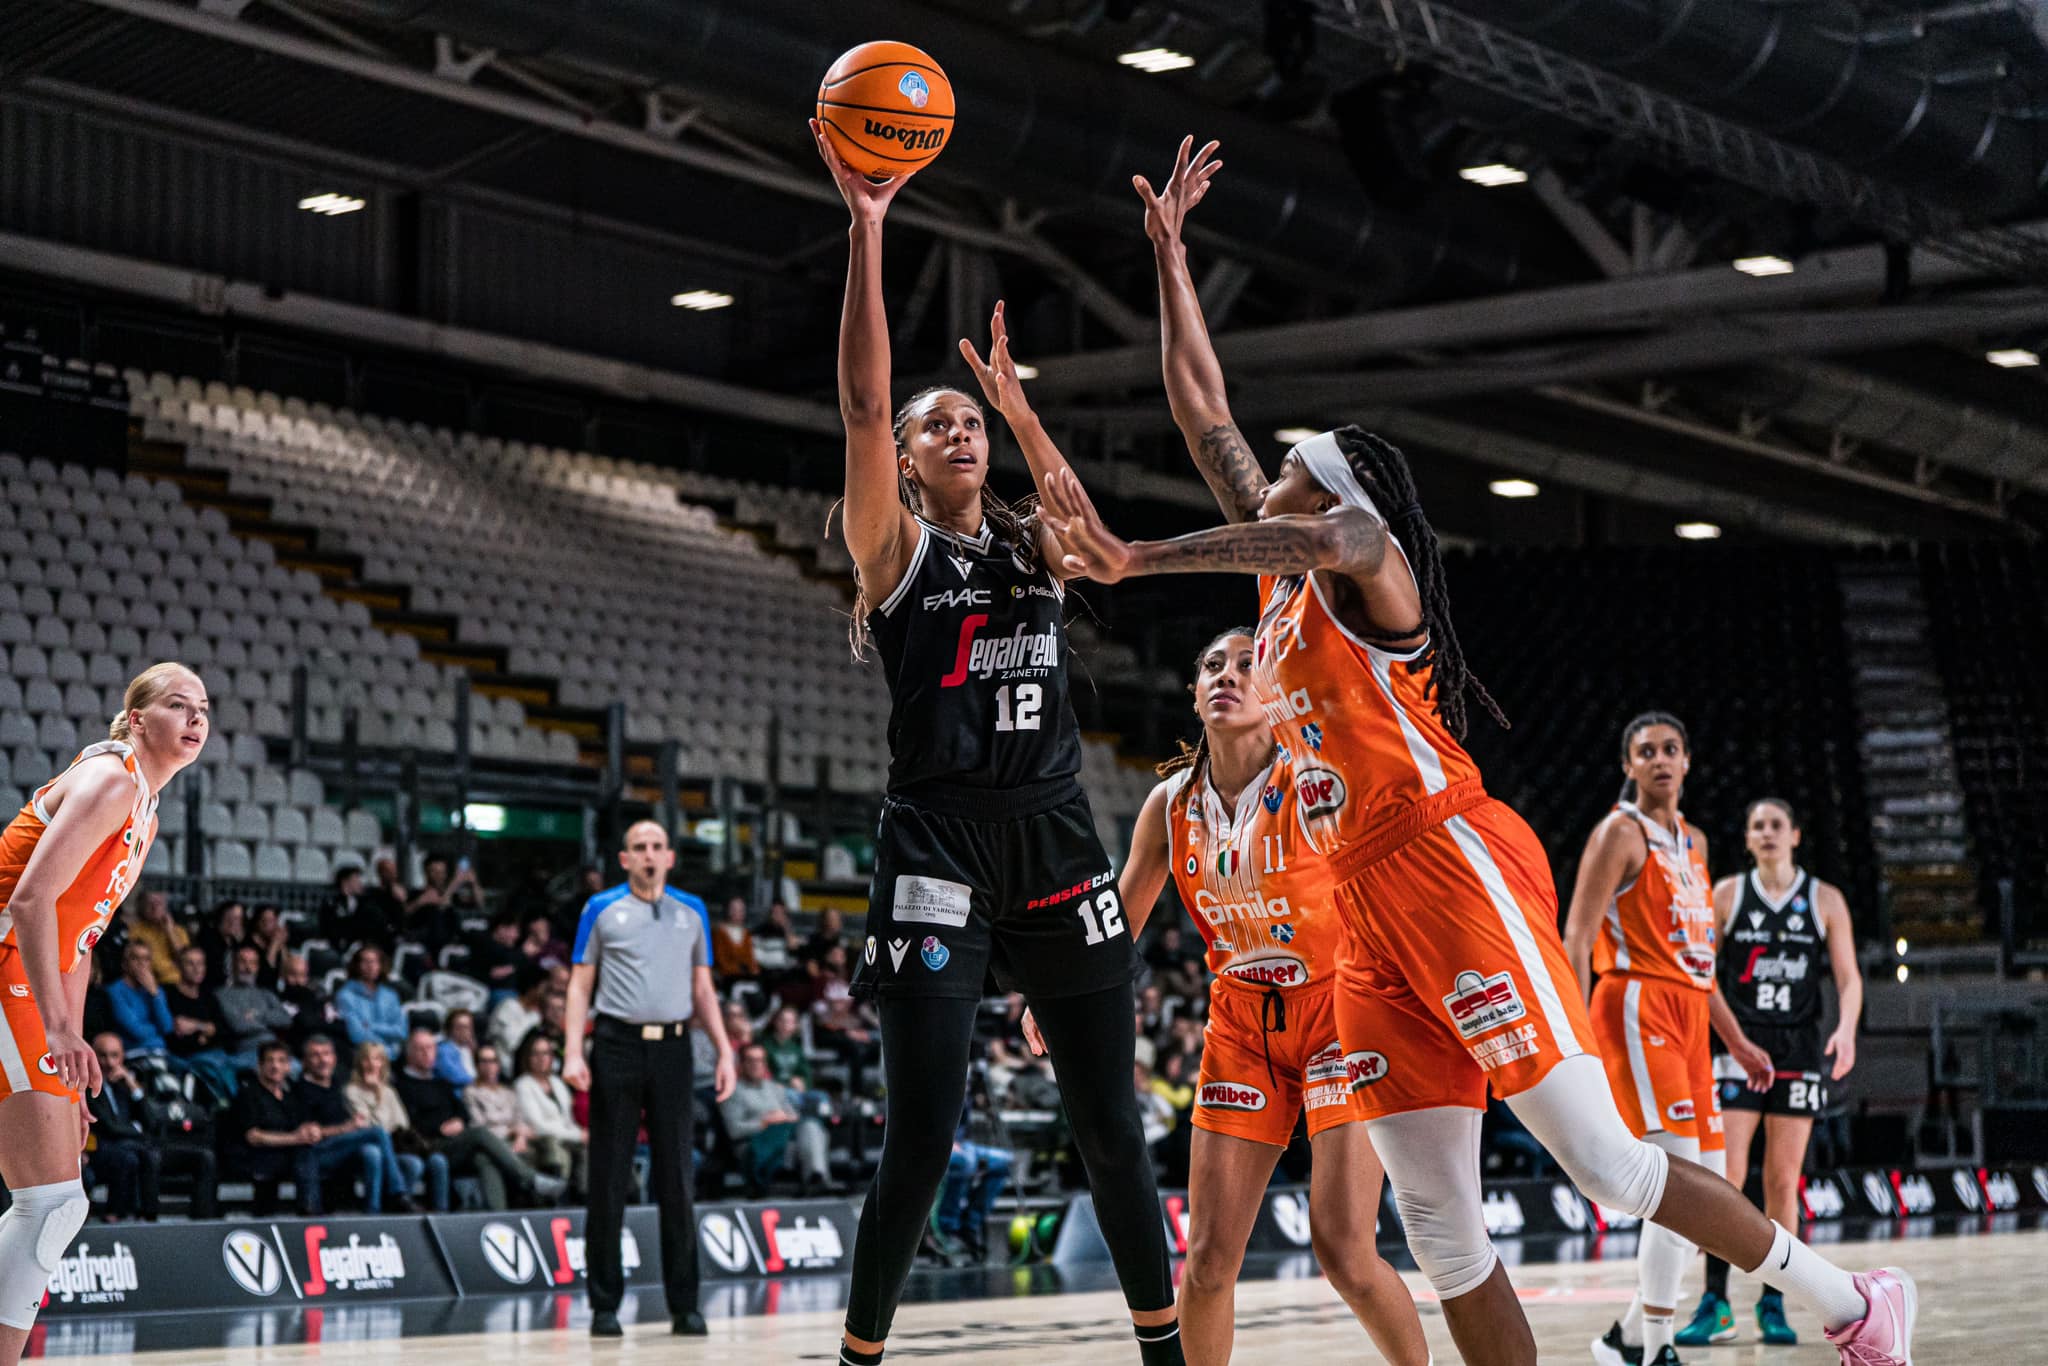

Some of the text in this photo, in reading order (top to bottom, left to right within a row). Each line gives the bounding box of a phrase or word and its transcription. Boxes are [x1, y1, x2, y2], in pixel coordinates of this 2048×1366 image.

[864, 117, 945, 151] Wilson
[923, 588, 992, 611] FAAC
[1001, 668, 1048, 679] ZANETTI
[995, 683, 1042, 731] 12
[1262, 834, 1287, 874] 11
[1077, 889, 1125, 946] 12
[1757, 984, 1791, 1010] 24
[1201, 1086, 1260, 1106] Wüber
[1789, 1081, 1819, 1111] 24
